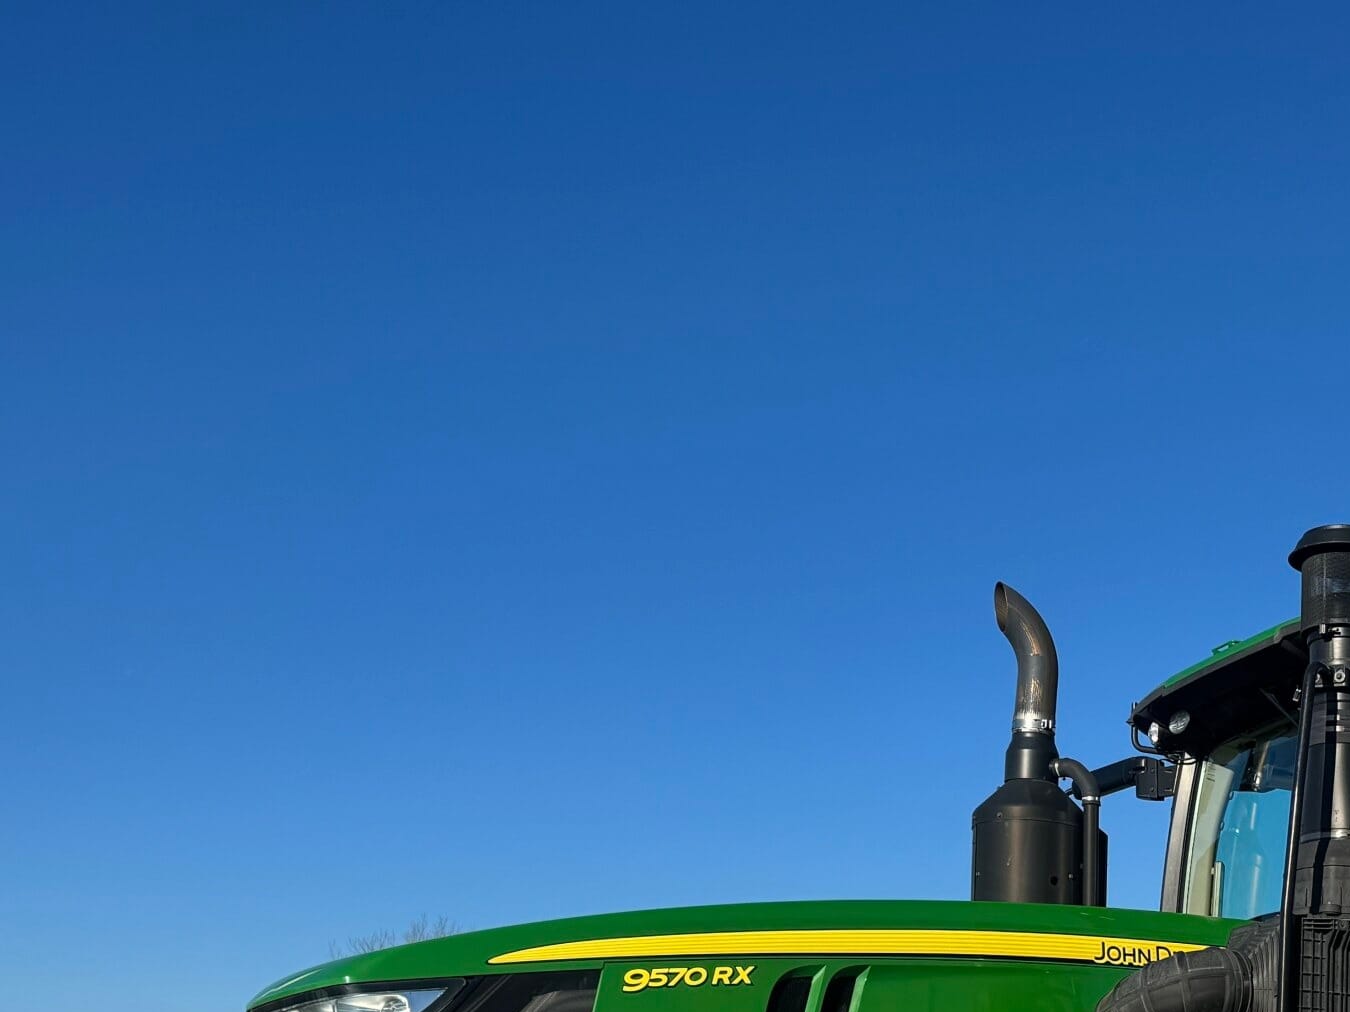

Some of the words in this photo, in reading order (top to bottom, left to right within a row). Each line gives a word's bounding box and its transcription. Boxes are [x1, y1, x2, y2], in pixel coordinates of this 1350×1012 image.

[1094, 941, 1151, 963] JOHN
[622, 967, 708, 993] 9570
[711, 965, 755, 986] RX
